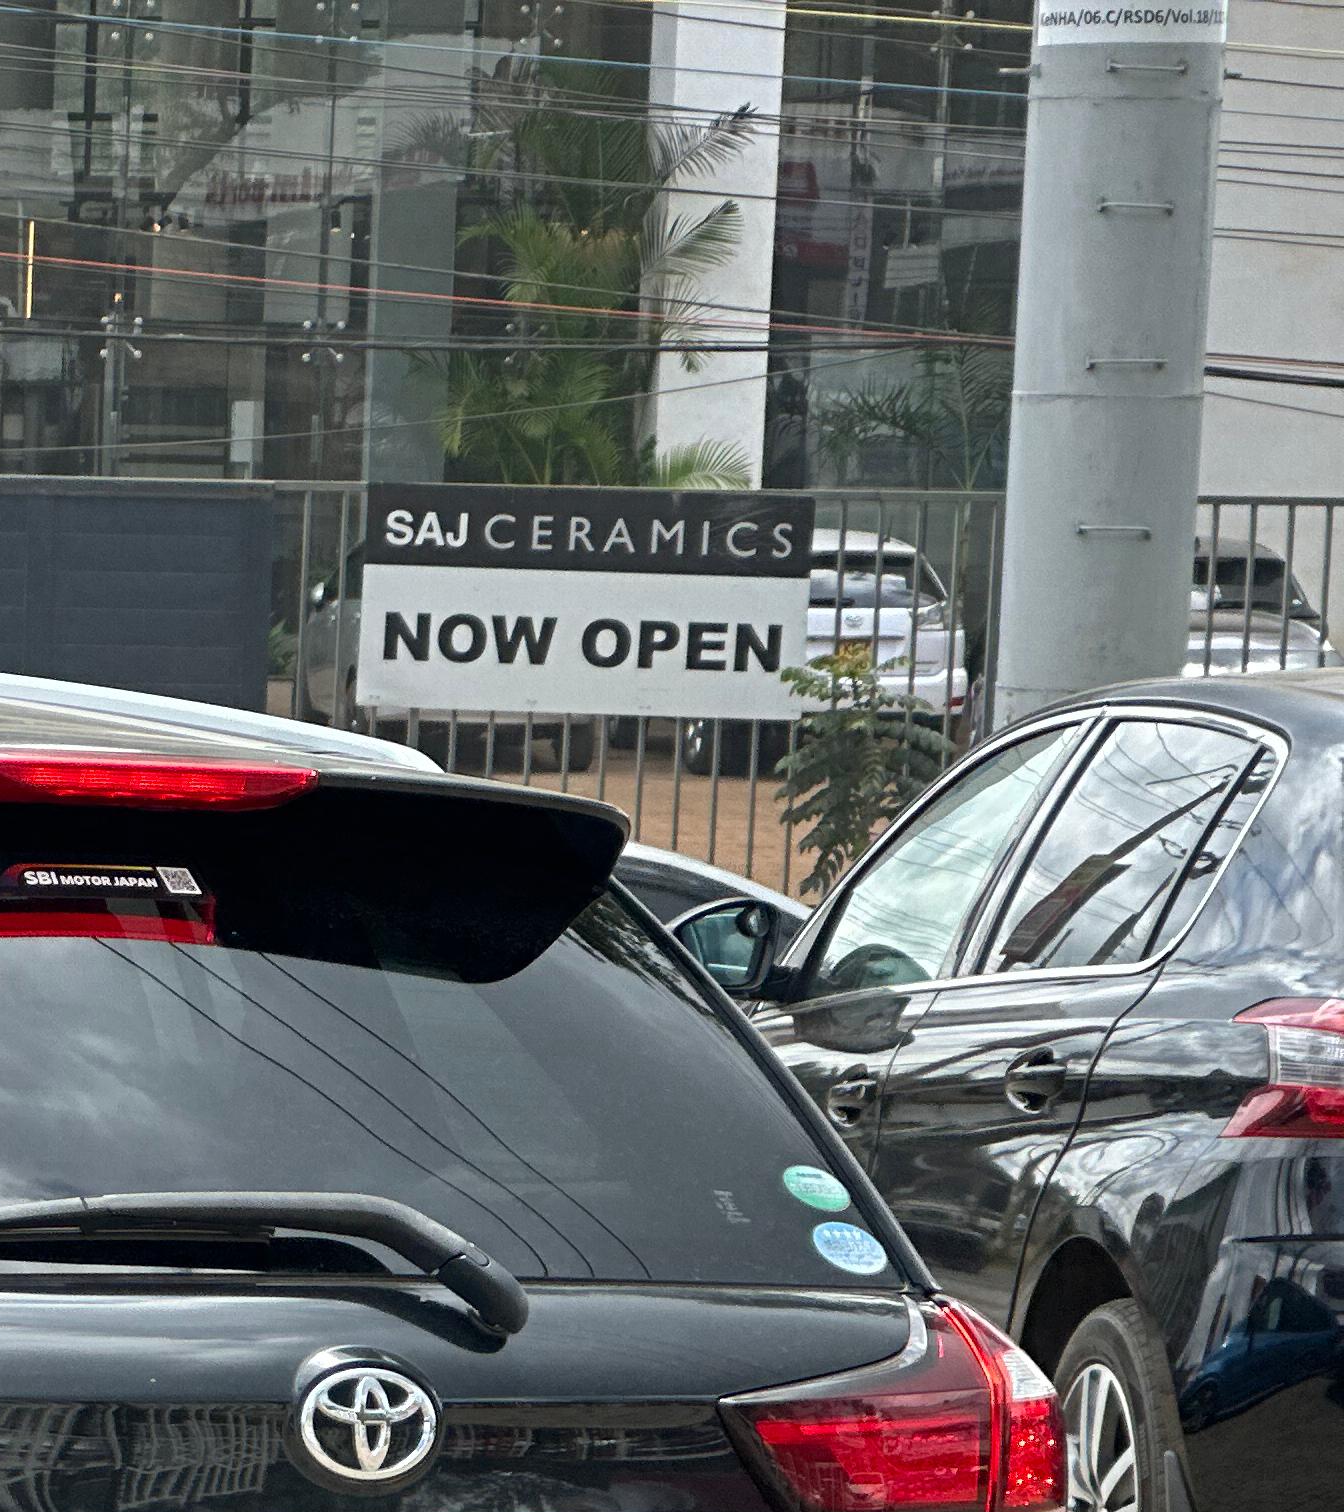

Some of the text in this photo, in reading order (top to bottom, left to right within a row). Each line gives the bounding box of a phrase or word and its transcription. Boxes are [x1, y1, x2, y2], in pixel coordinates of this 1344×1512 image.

[385, 508, 794, 560] SAJ CERAMICS
[382, 612, 558, 666] NOW
[580, 618, 783, 672] OPEN
[24, 871, 158, 888] SBI MOTOR JAPAN
